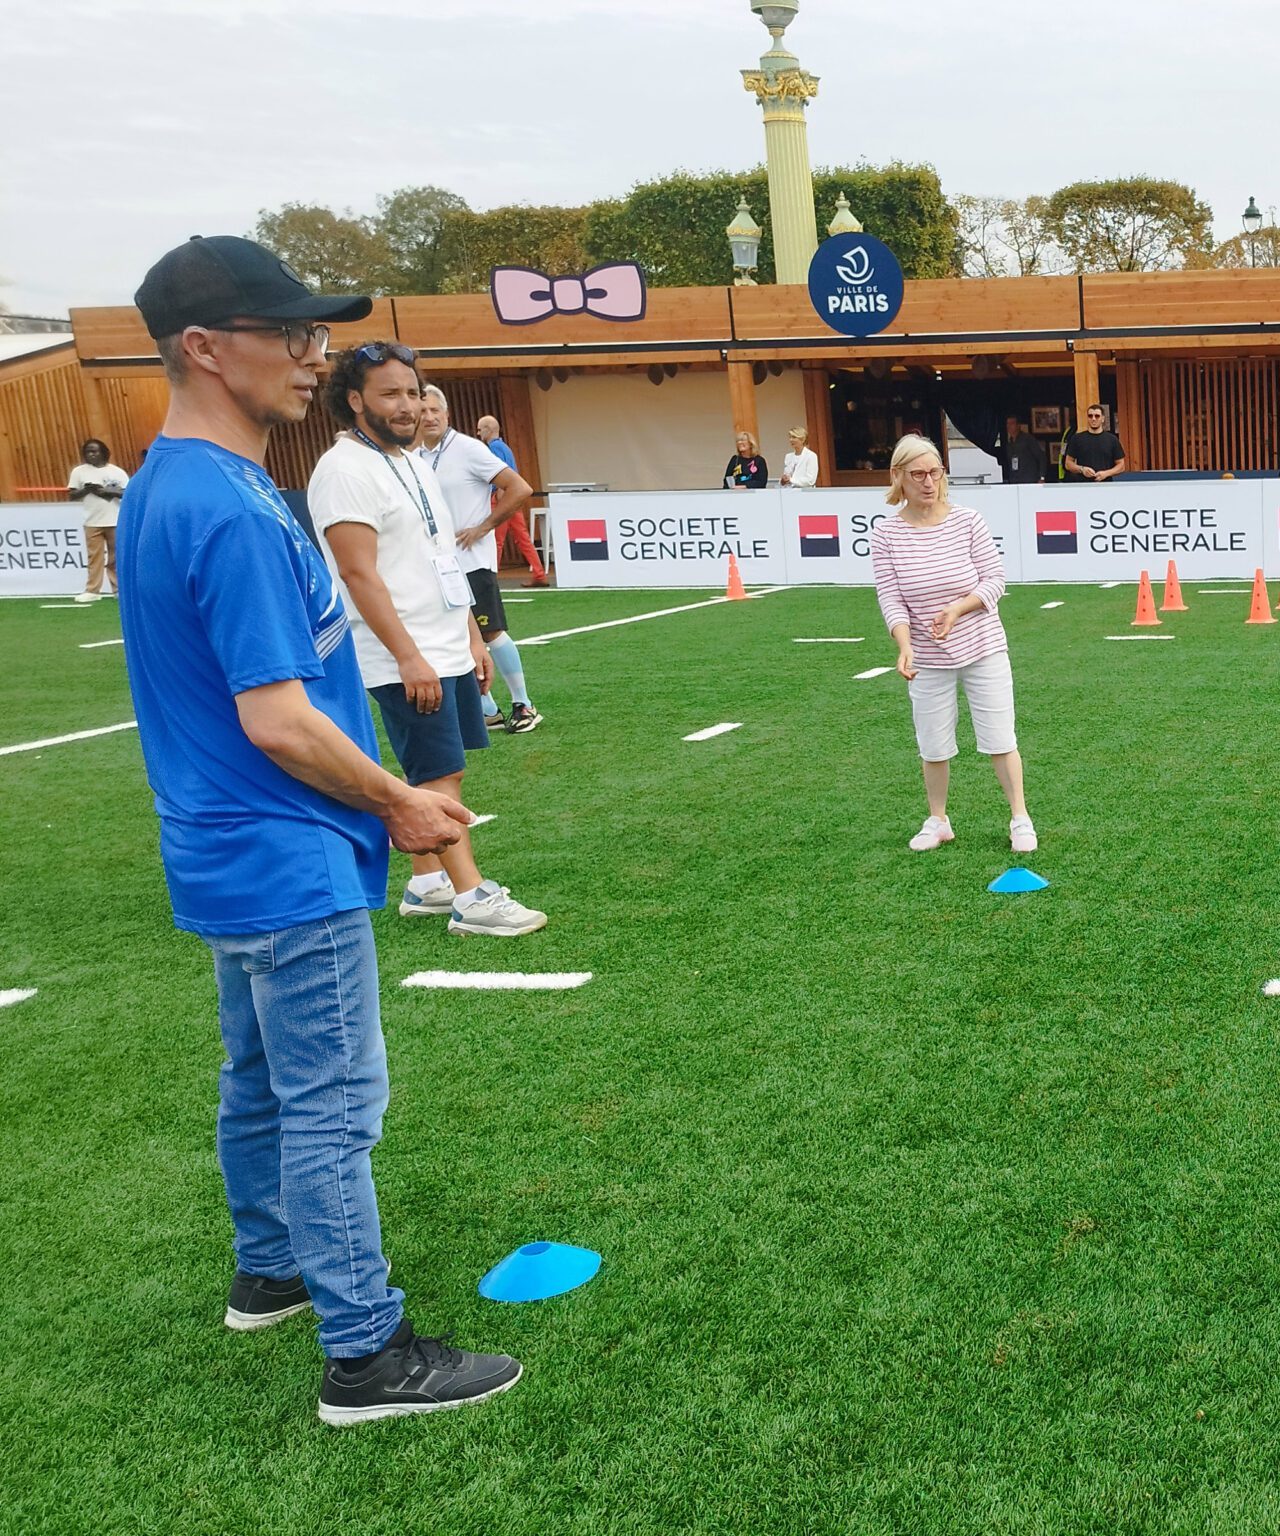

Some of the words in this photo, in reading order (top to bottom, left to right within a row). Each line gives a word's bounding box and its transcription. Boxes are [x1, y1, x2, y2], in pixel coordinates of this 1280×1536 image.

[837, 286, 862, 294] VILLE
[866, 285, 878, 293] DE
[828, 293, 889, 313] PARIS
[619, 517, 741, 537] SOCIETE
[1090, 509, 1217, 529] SOCIETE
[0, 529, 81, 548] CIETE
[1090, 532, 1247, 553] GENERALE
[620, 540, 769, 560] GENERALE
